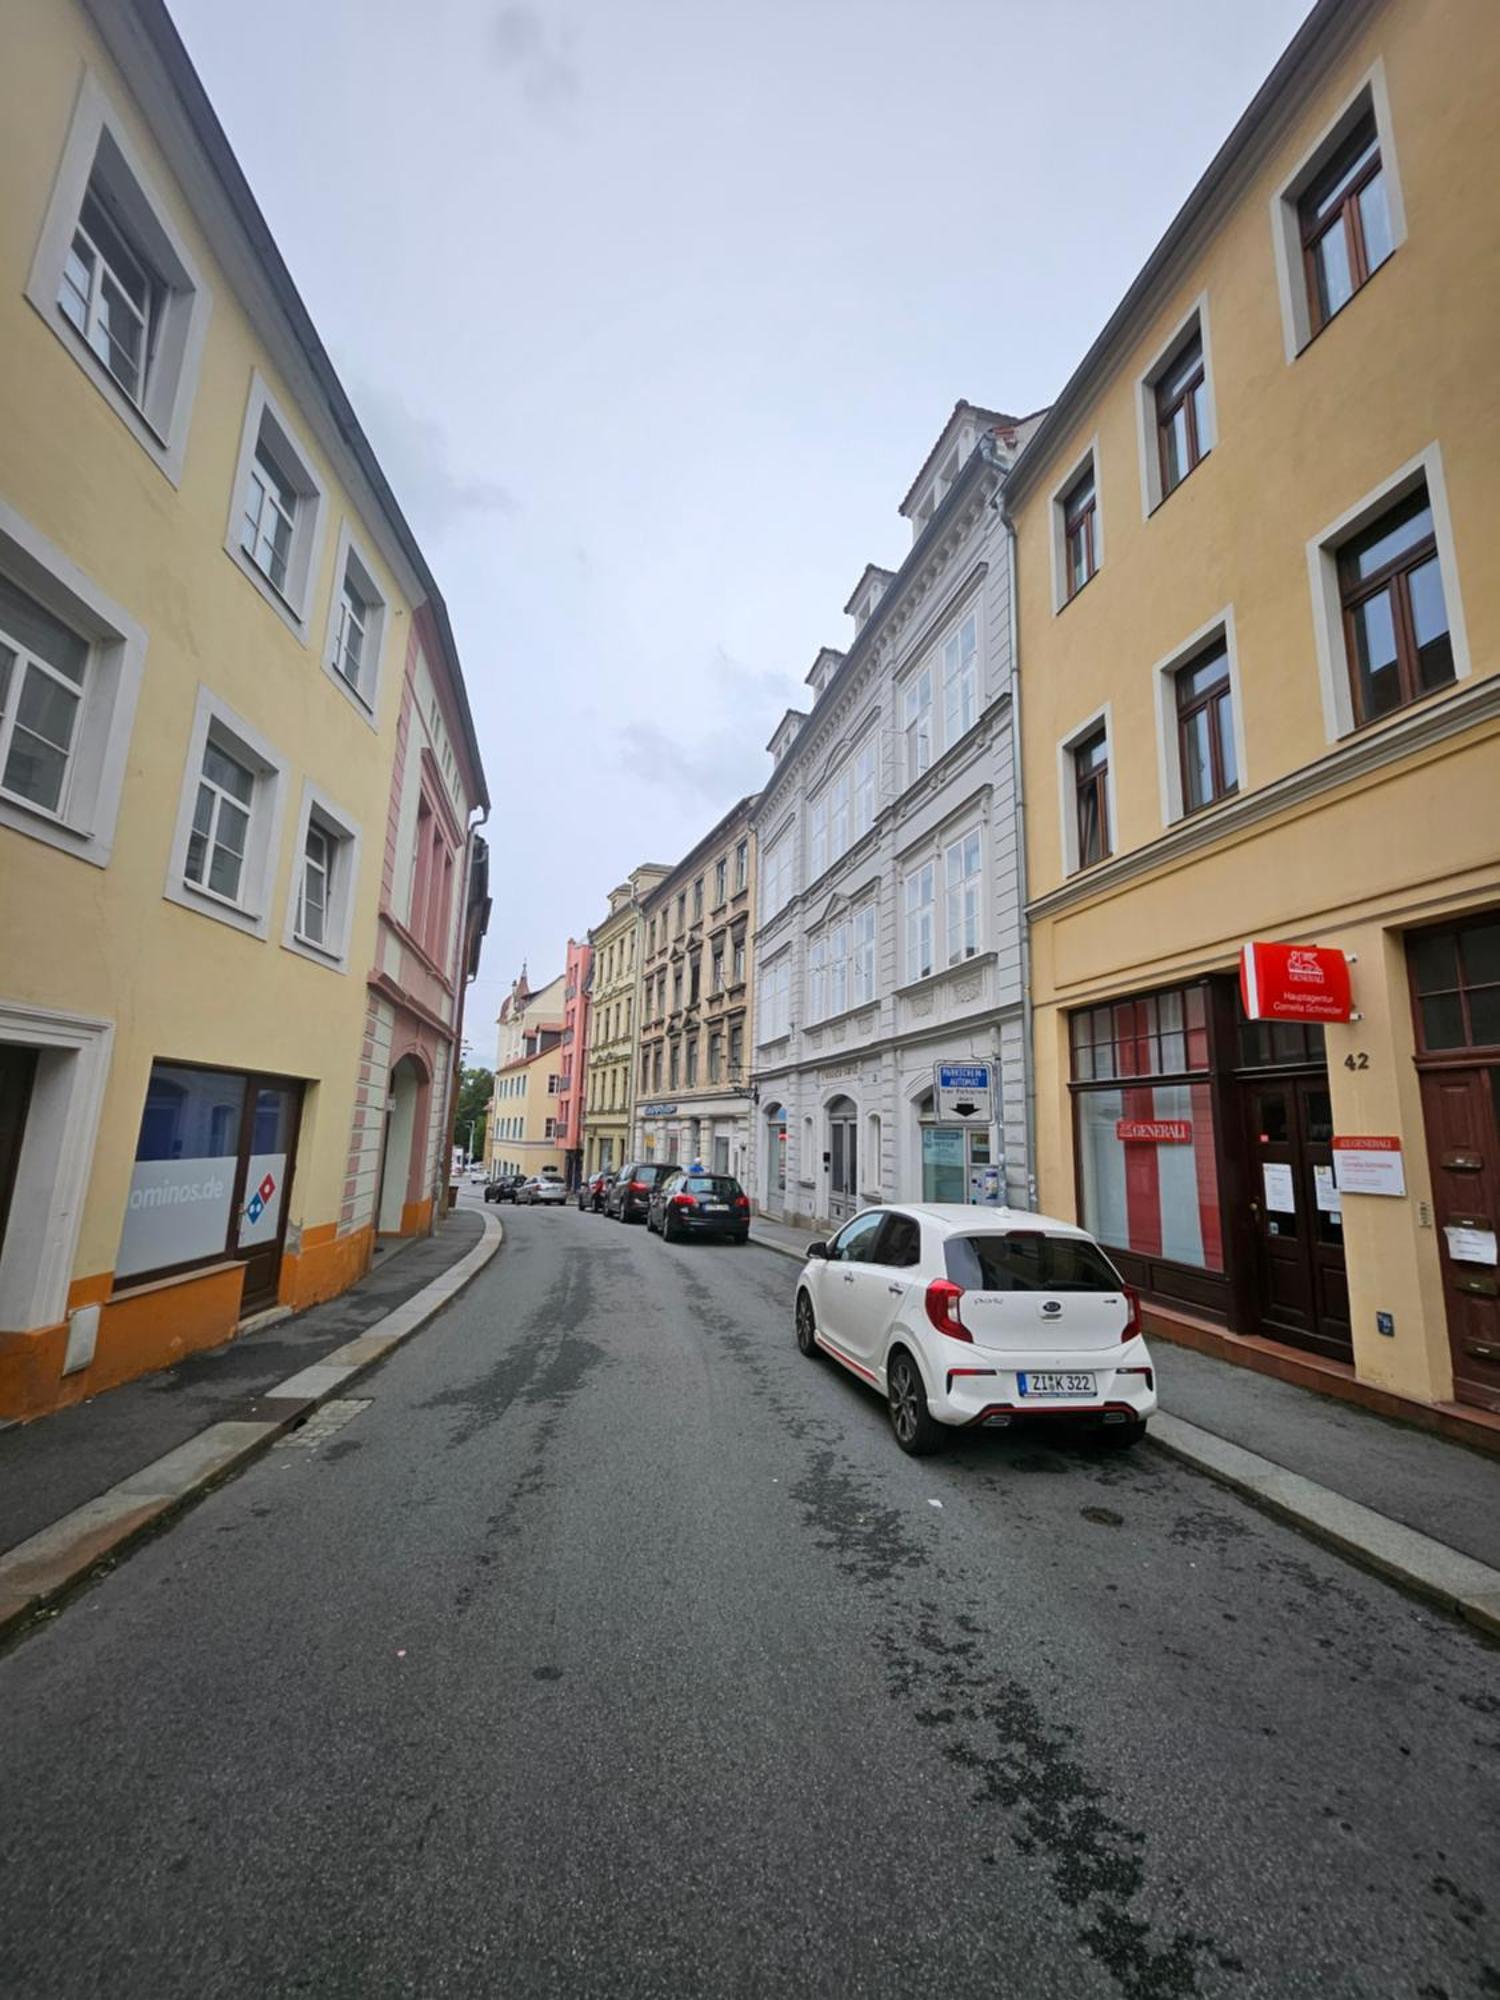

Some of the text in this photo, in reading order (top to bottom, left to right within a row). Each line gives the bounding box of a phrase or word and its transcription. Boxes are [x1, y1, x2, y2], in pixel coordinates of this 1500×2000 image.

[1283, 991, 1334, 1003] Hauptagentur
[1344, 1052, 1369, 1071] 42
[1132, 1123, 1185, 1138] GENERALI
[130, 1176, 225, 1209] ominos.de
[1032, 1375, 1091, 1391] ZI K 322
